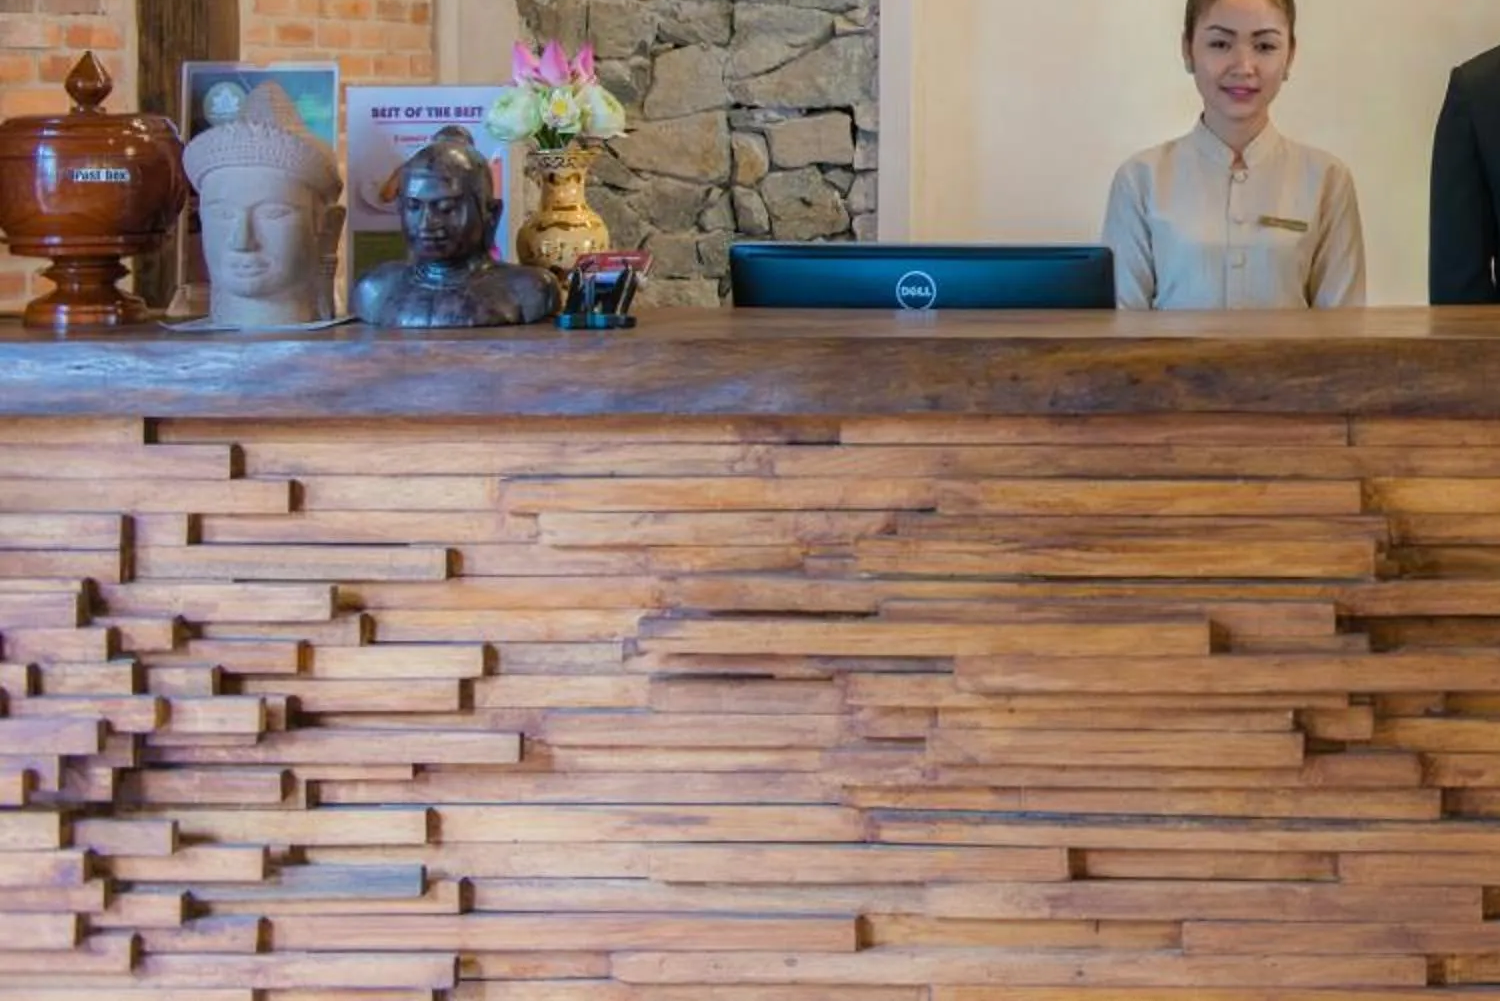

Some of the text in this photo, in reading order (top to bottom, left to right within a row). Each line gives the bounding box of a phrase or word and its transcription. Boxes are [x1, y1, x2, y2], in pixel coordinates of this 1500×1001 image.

[371, 106, 483, 118] BEST OF THE BEST
[902, 286, 932, 296] DELL
